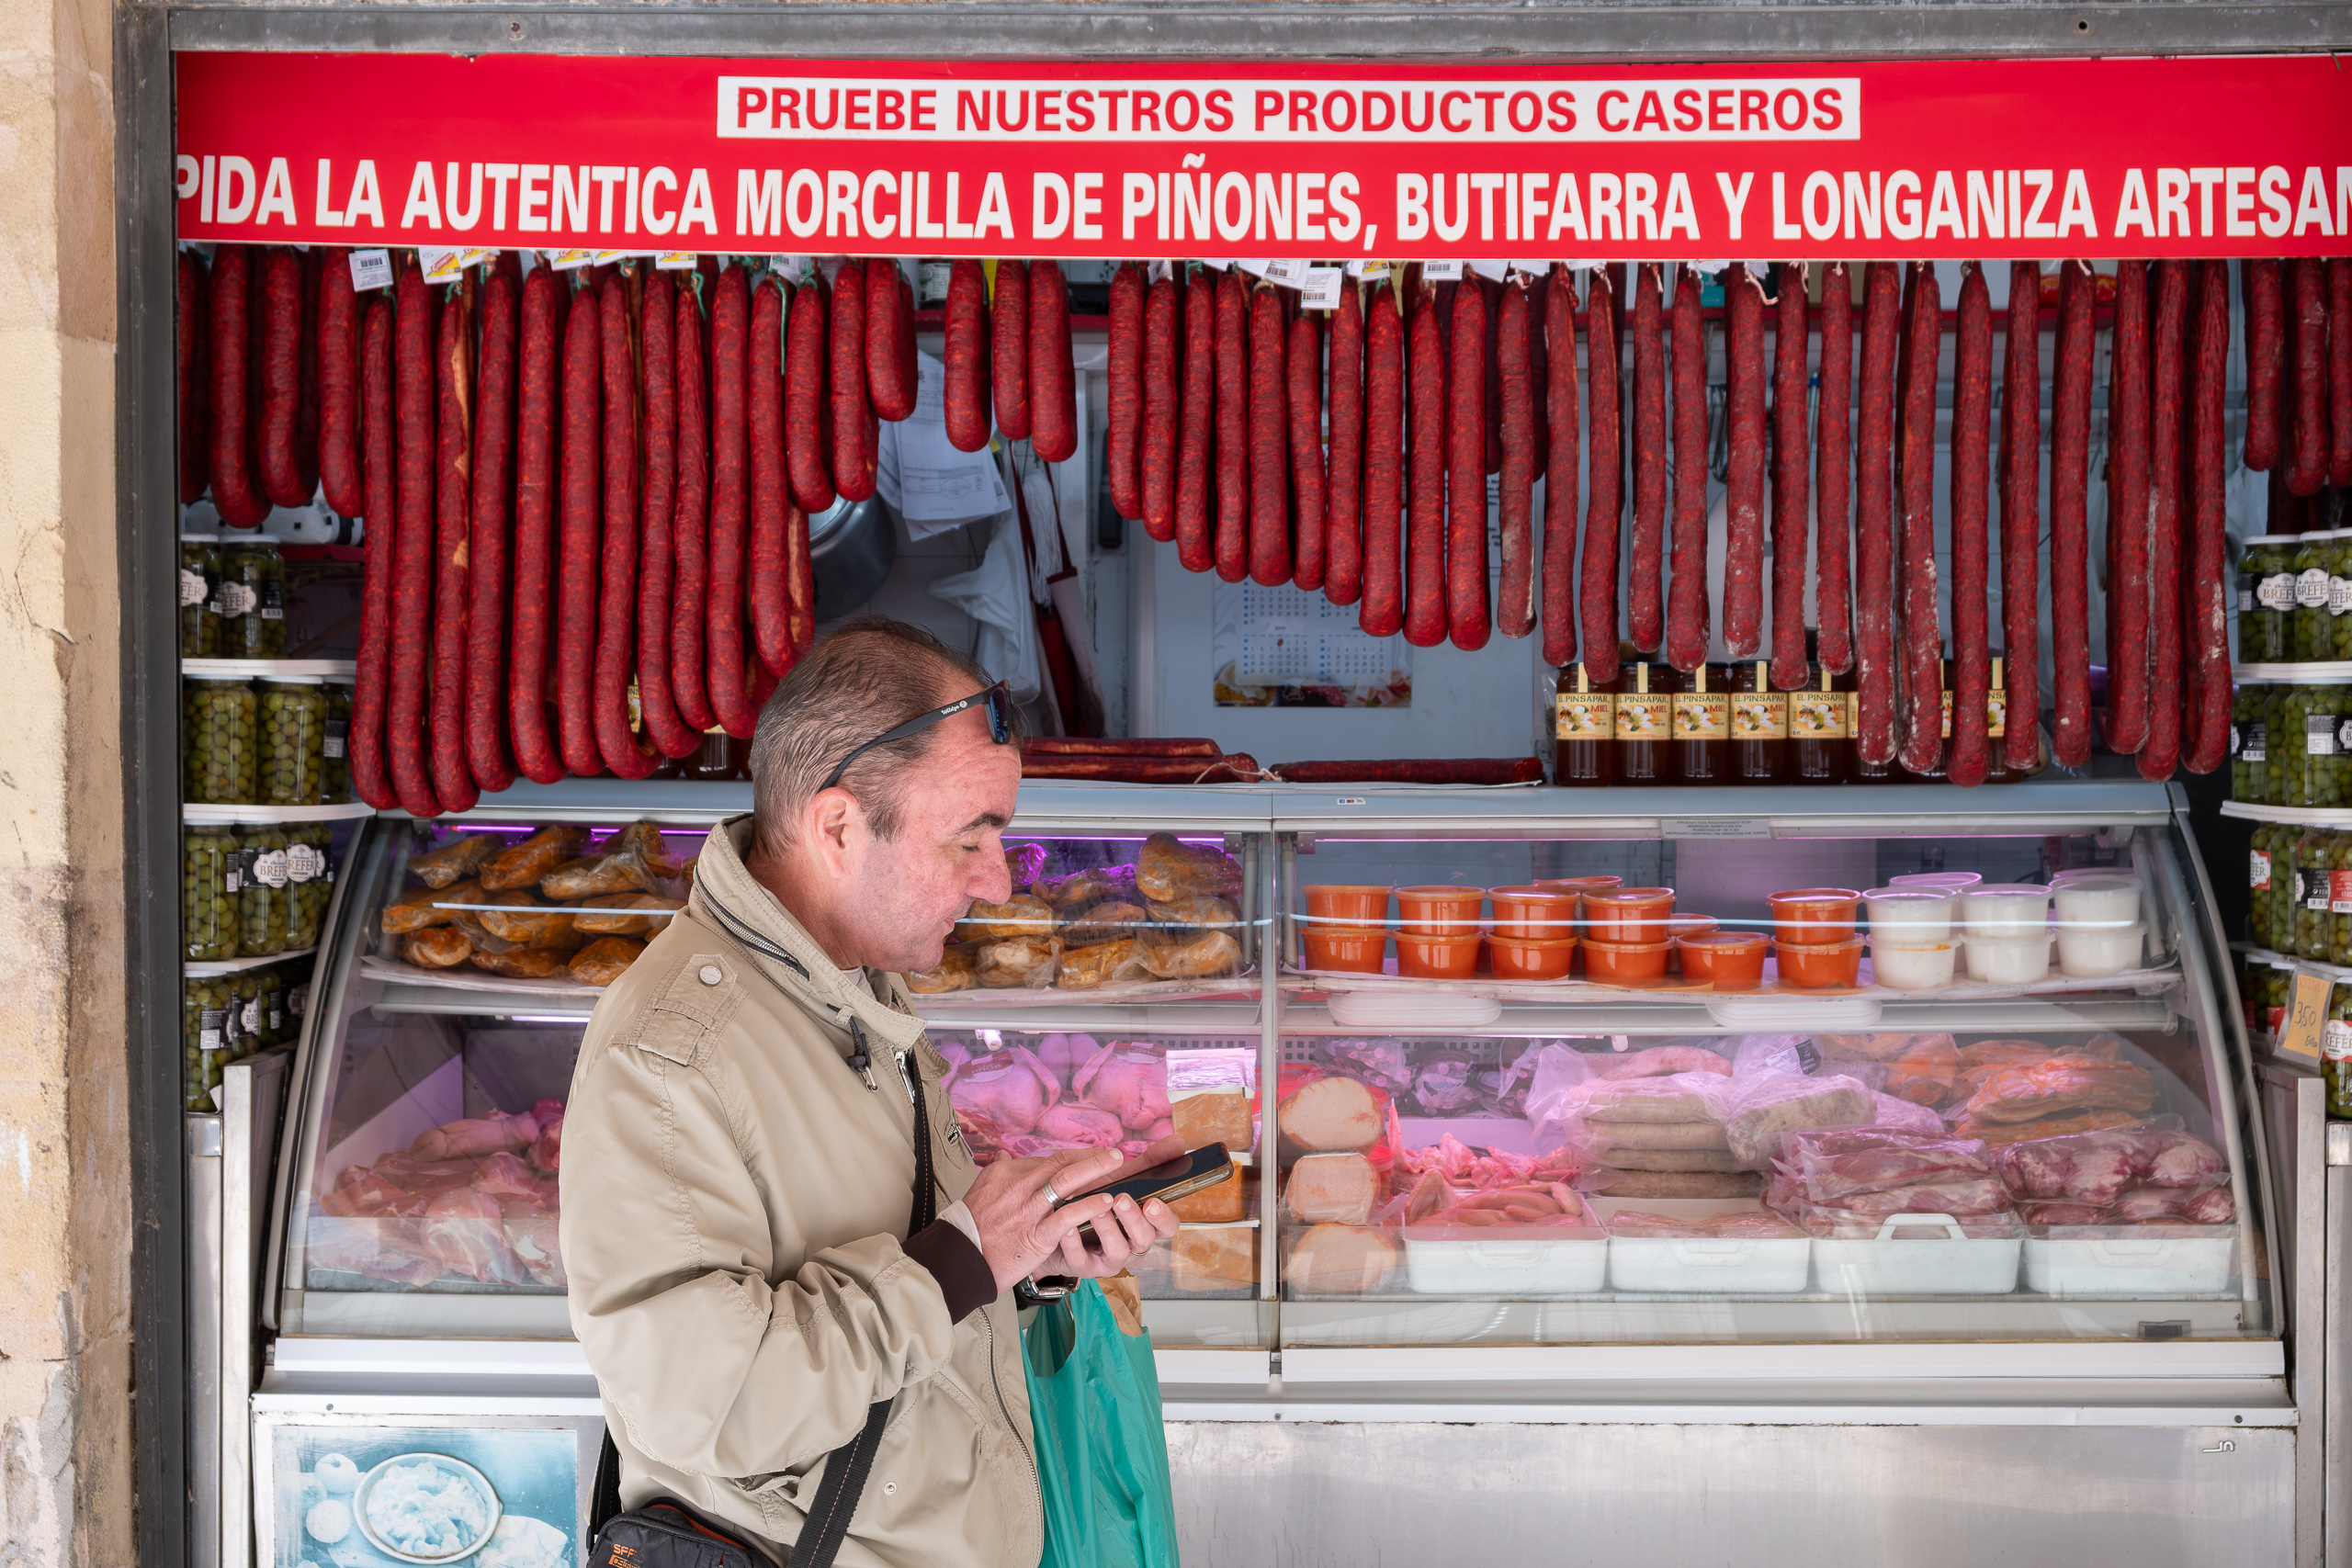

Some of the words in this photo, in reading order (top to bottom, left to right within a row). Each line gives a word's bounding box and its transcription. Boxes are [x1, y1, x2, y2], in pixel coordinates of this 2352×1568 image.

[738, 90, 936, 130] PRUEBE
[957, 90, 1233, 132] NUESTROS
[1256, 90, 1576, 133] PRODUCTOS
[1598, 88, 1842, 131] CASEROS
[178, 155, 297, 225] PIDA
[316, 159, 384, 227] LA
[401, 161, 718, 235] AUTENTICA
[736, 168, 1014, 241] MORCILLA
[1033, 173, 1102, 239] DE
[1123, 153, 1377, 250] PIÑONES,
[1397, 173, 1701, 242] BUTIFARRA
[1716, 173, 1754, 239] Y
[1773, 170, 2098, 240] LONGANIZA
[2297, 583, 2329, 595] BREFE
[2263, 589, 2295, 599] BREF
[1590, 705, 1609, 713] MIEL
[1650, 705, 1668, 713] MIEL
[1709, 705, 1726, 713] MIEL
[1770, 704, 1786, 712] MIEL
